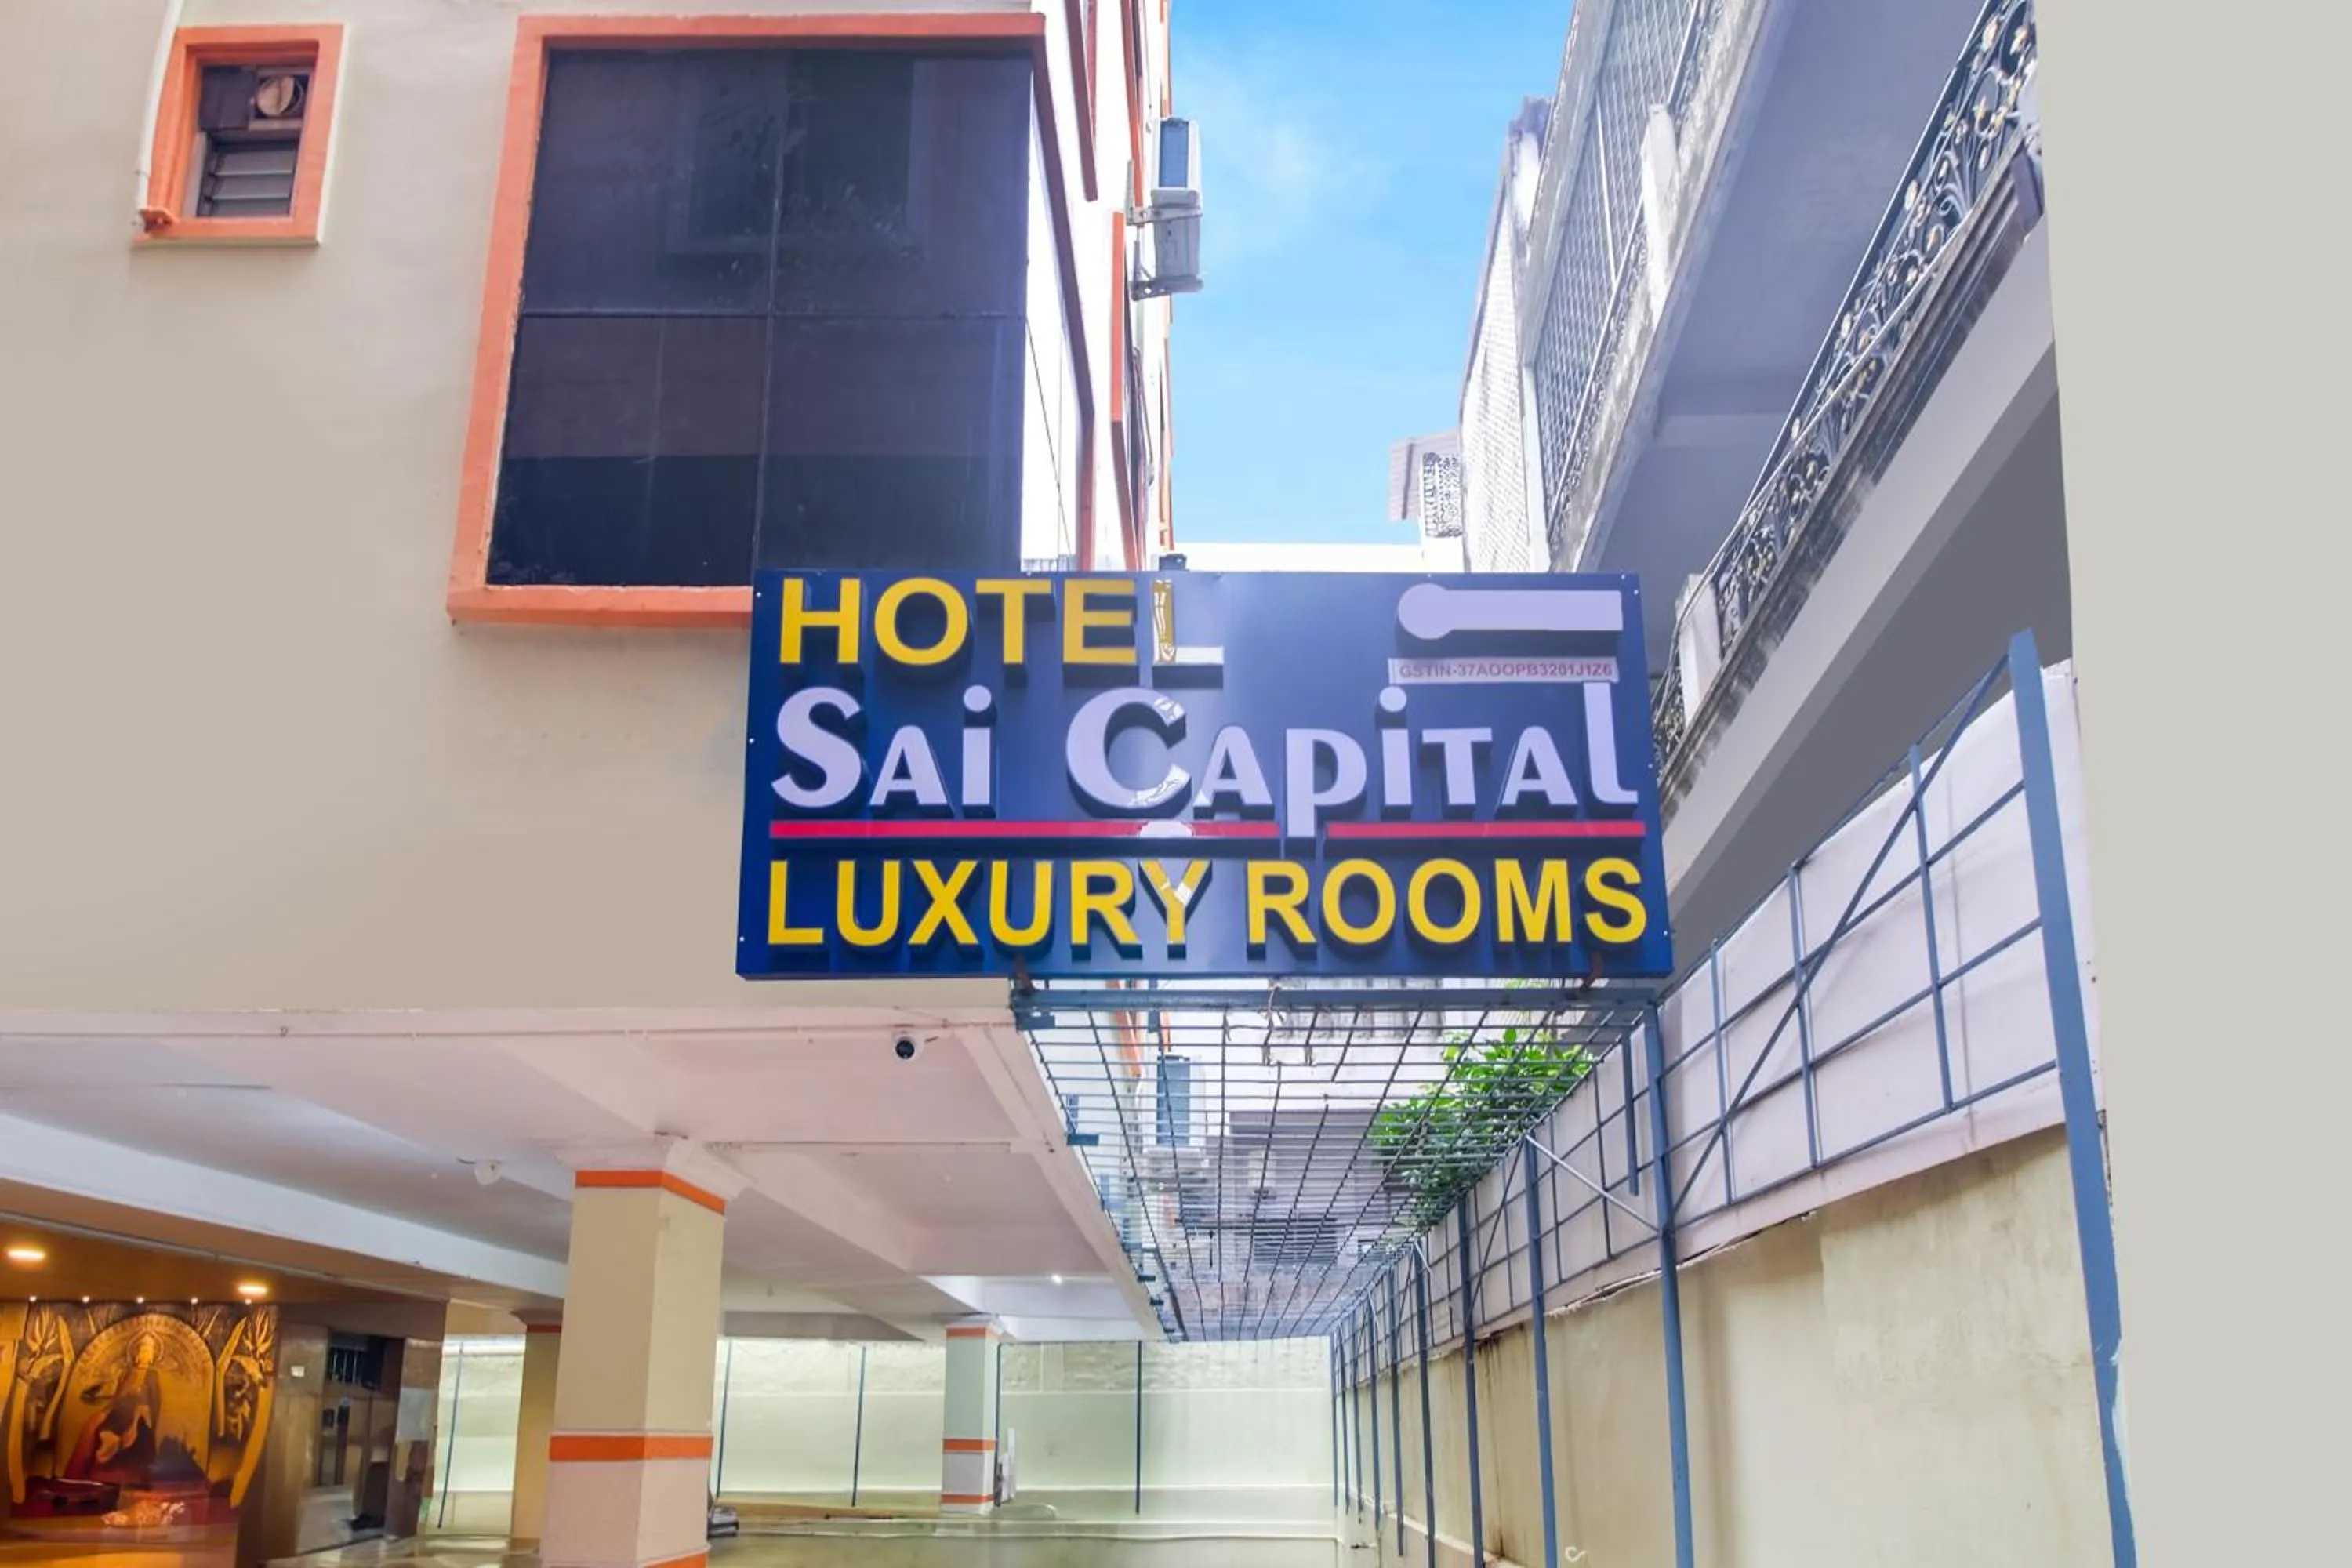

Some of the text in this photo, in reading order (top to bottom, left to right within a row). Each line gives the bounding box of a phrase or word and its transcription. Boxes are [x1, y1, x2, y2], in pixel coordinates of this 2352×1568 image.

[779, 579, 1225, 665] HOTEL
[767, 858, 1647, 946] LUXURY ROOMS
